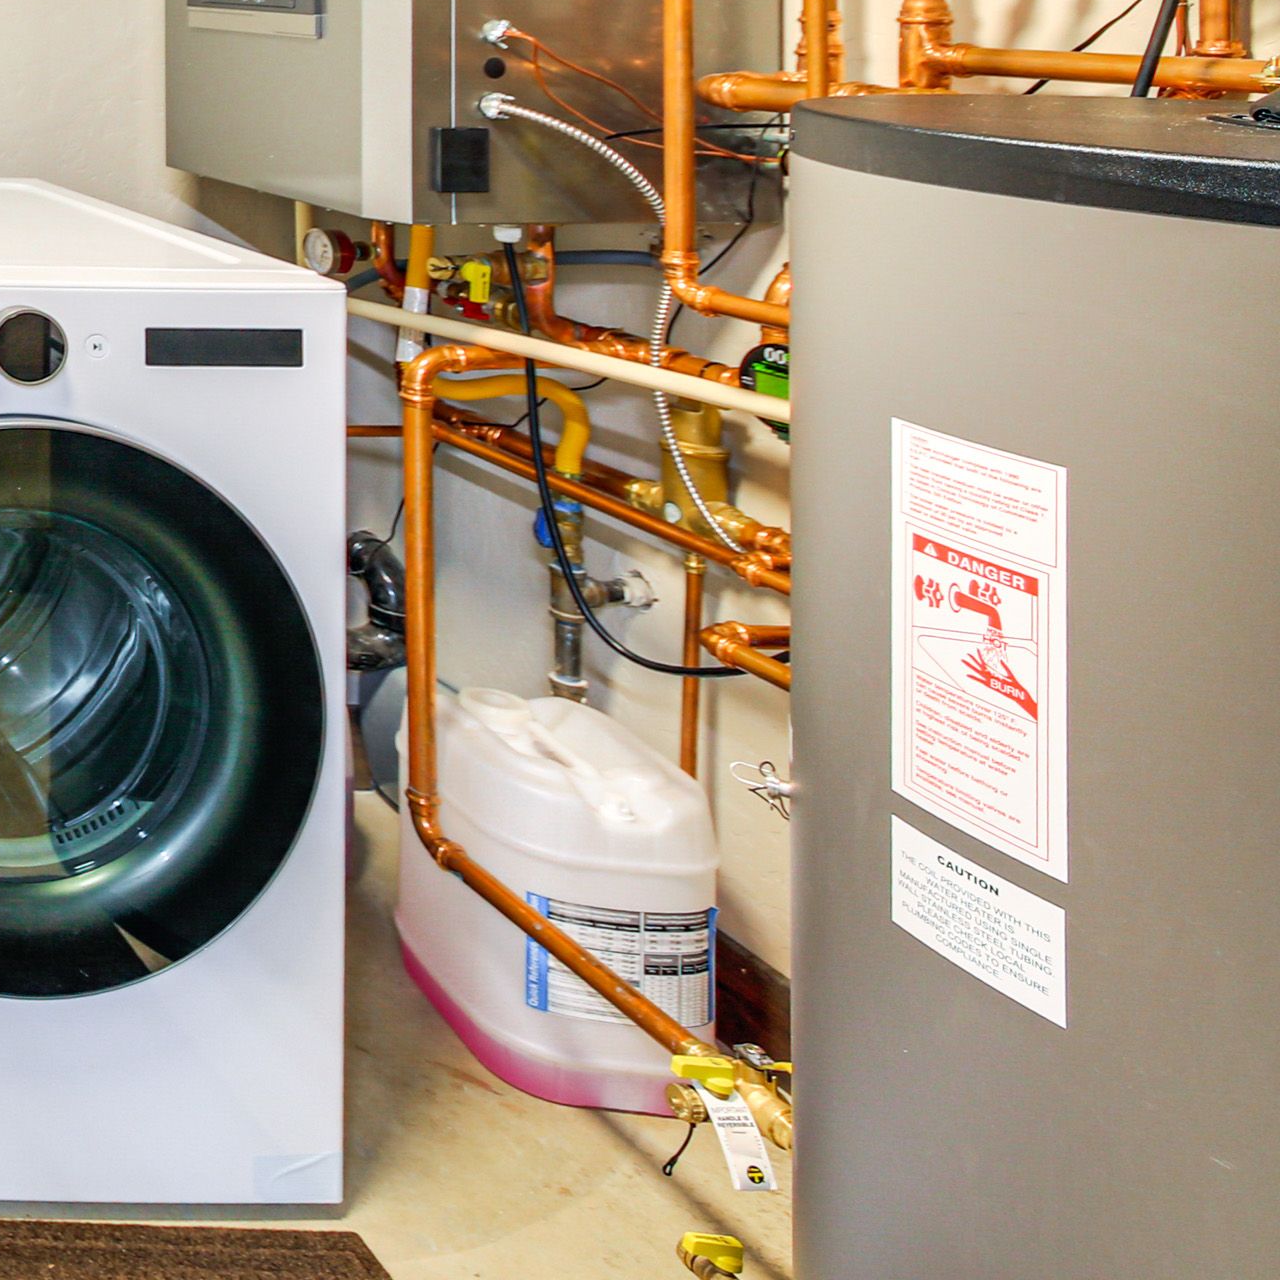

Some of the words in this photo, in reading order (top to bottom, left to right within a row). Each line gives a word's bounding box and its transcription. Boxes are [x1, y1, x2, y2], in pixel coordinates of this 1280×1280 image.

[947, 551, 1026, 590] DANGER
[983, 633, 1008, 652] HOT
[990, 676, 1025, 701] BURN
[901, 849, 915, 866] THE
[918, 860, 937, 880] COIL
[940, 874, 990, 911] PROVIDED
[993, 904, 1021, 928] WITH
[1025, 921, 1051, 944] THIS
[926, 876, 957, 902] WATER
[960, 896, 1001, 928] HEATER
[1004, 921, 1015, 935] IS
[937, 853, 999, 898] CAUTION
[897, 877, 918, 898] WALL
[921, 892, 970, 931] STAINLESS
[973, 924, 1005, 952] STEEL
[899, 868, 972, 921] MANUFACTURED
[974, 914, 1007, 942] USING
[1010, 933, 1052, 968] SINGLE
[916, 899, 951, 929] PLEASE
[953, 922, 988, 951] CHECK
[990, 943, 1025, 973] LOCAL
[902, 899, 945, 936] PLUMBING
[947, 929, 981, 958] CODES
[985, 952, 998, 968] TO
[1002, 960, 1049, 999] ENSURE
